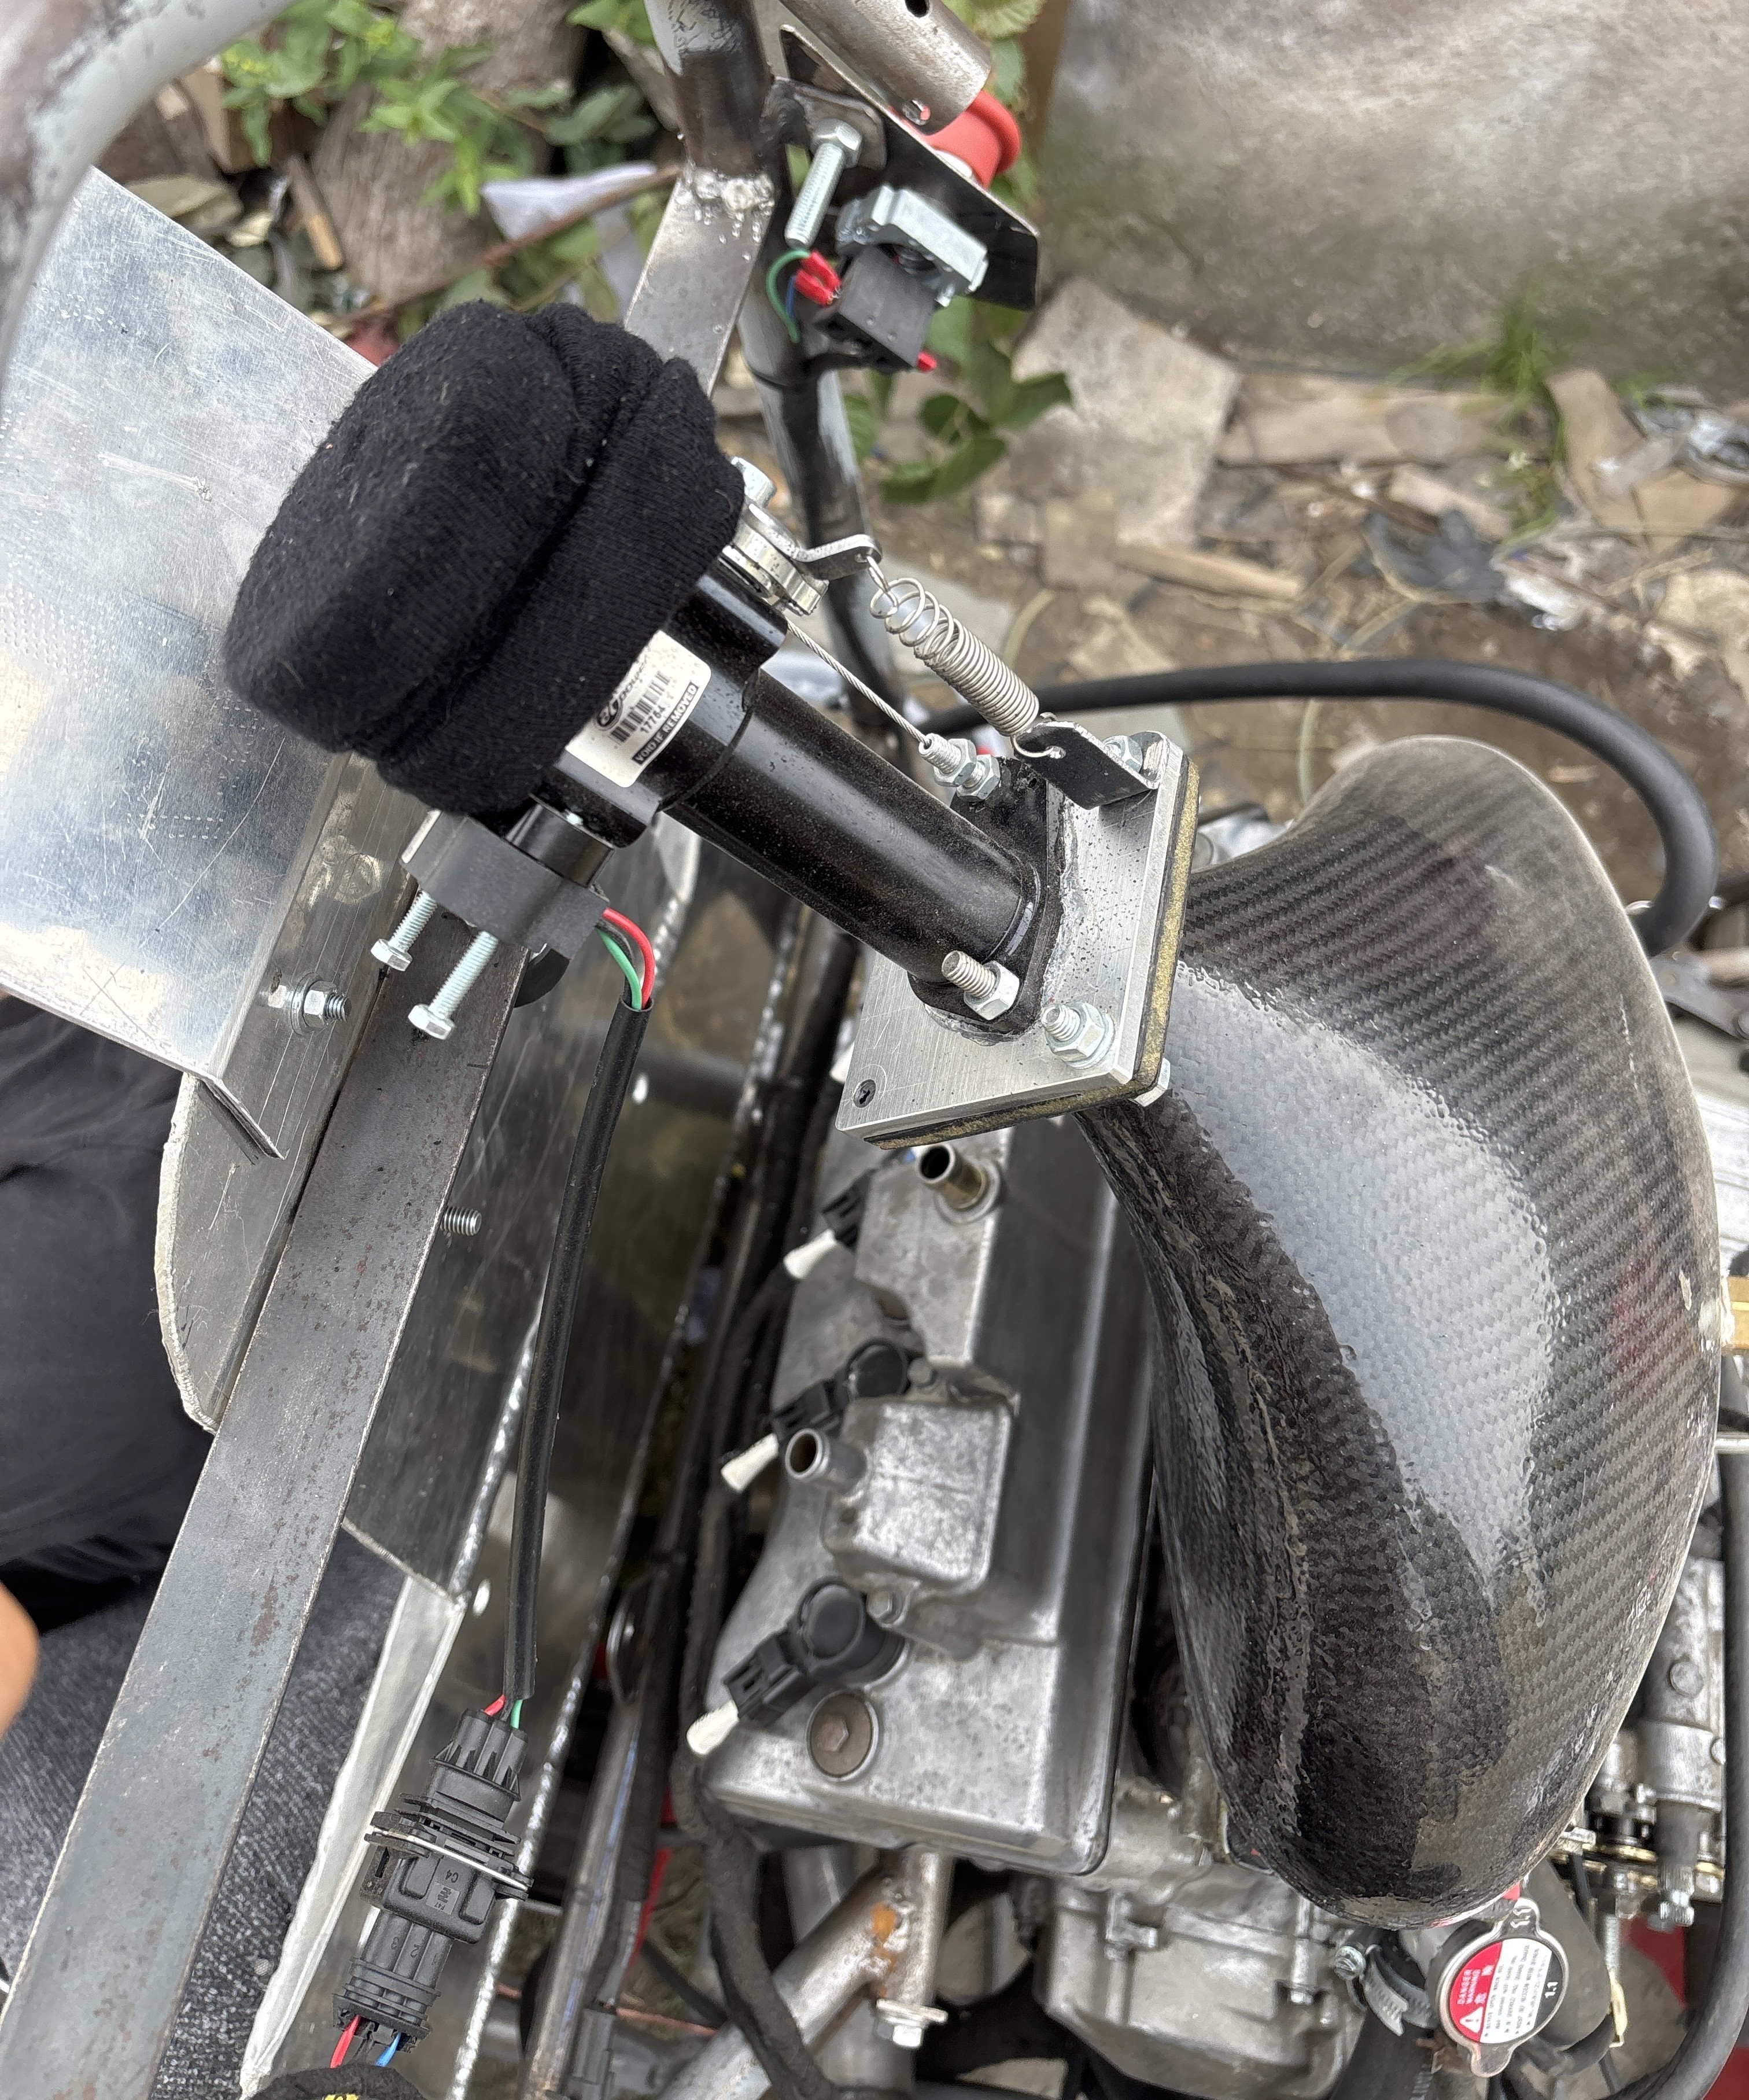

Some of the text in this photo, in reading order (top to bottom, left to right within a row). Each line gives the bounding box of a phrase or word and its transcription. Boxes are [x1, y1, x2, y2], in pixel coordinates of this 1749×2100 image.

[636, 685, 696, 762] VOID IF REMOVED
[445, 1869, 459, 1883] C4
[410, 1944, 420, 1958] 2
[1457, 1969, 1473, 2005] DANGER
[1465, 1969, 1481, 2005] WARNING
[1545, 1981, 1558, 1999] 1.1
